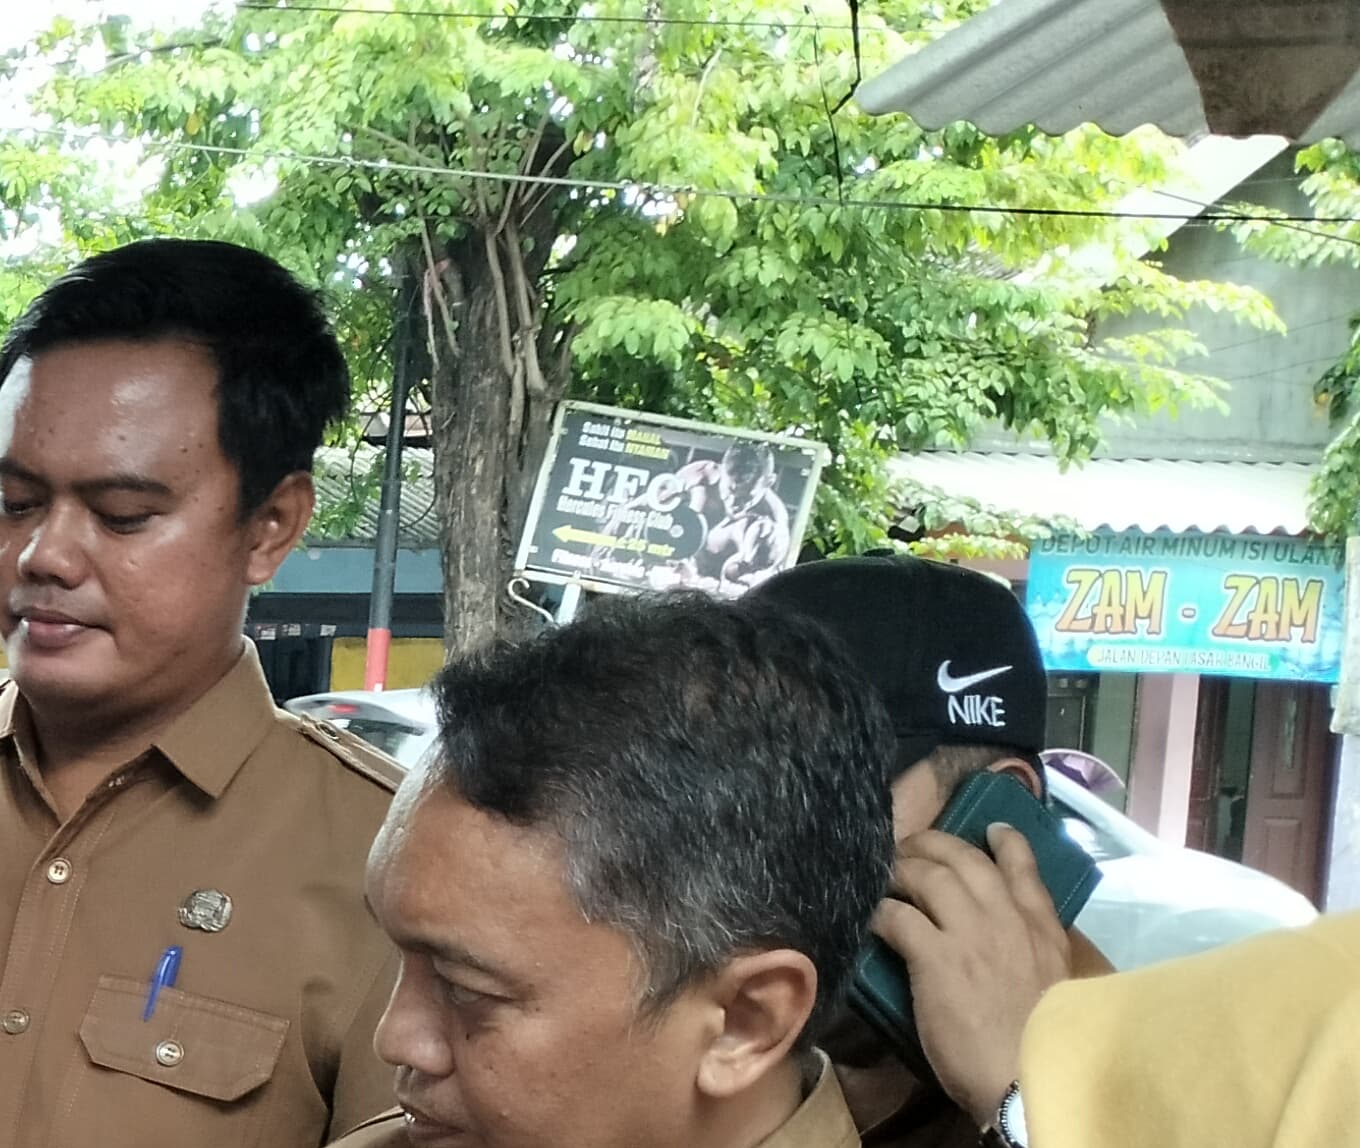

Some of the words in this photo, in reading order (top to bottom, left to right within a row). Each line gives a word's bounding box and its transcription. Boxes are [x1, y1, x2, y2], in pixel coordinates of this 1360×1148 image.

[561, 457, 683, 512] HFC
[1040, 533, 1120, 555] DEPOT
[1121, 535, 1158, 557] AIR
[1160, 536, 1237, 559] MINUM
[1241, 541, 1269, 562] ISI
[1055, 568, 1168, 635] ZAM
[1212, 574, 1325, 644] ZAM
[1097, 647, 1136, 664] JALAN
[947, 694, 1006, 727] NIKE
